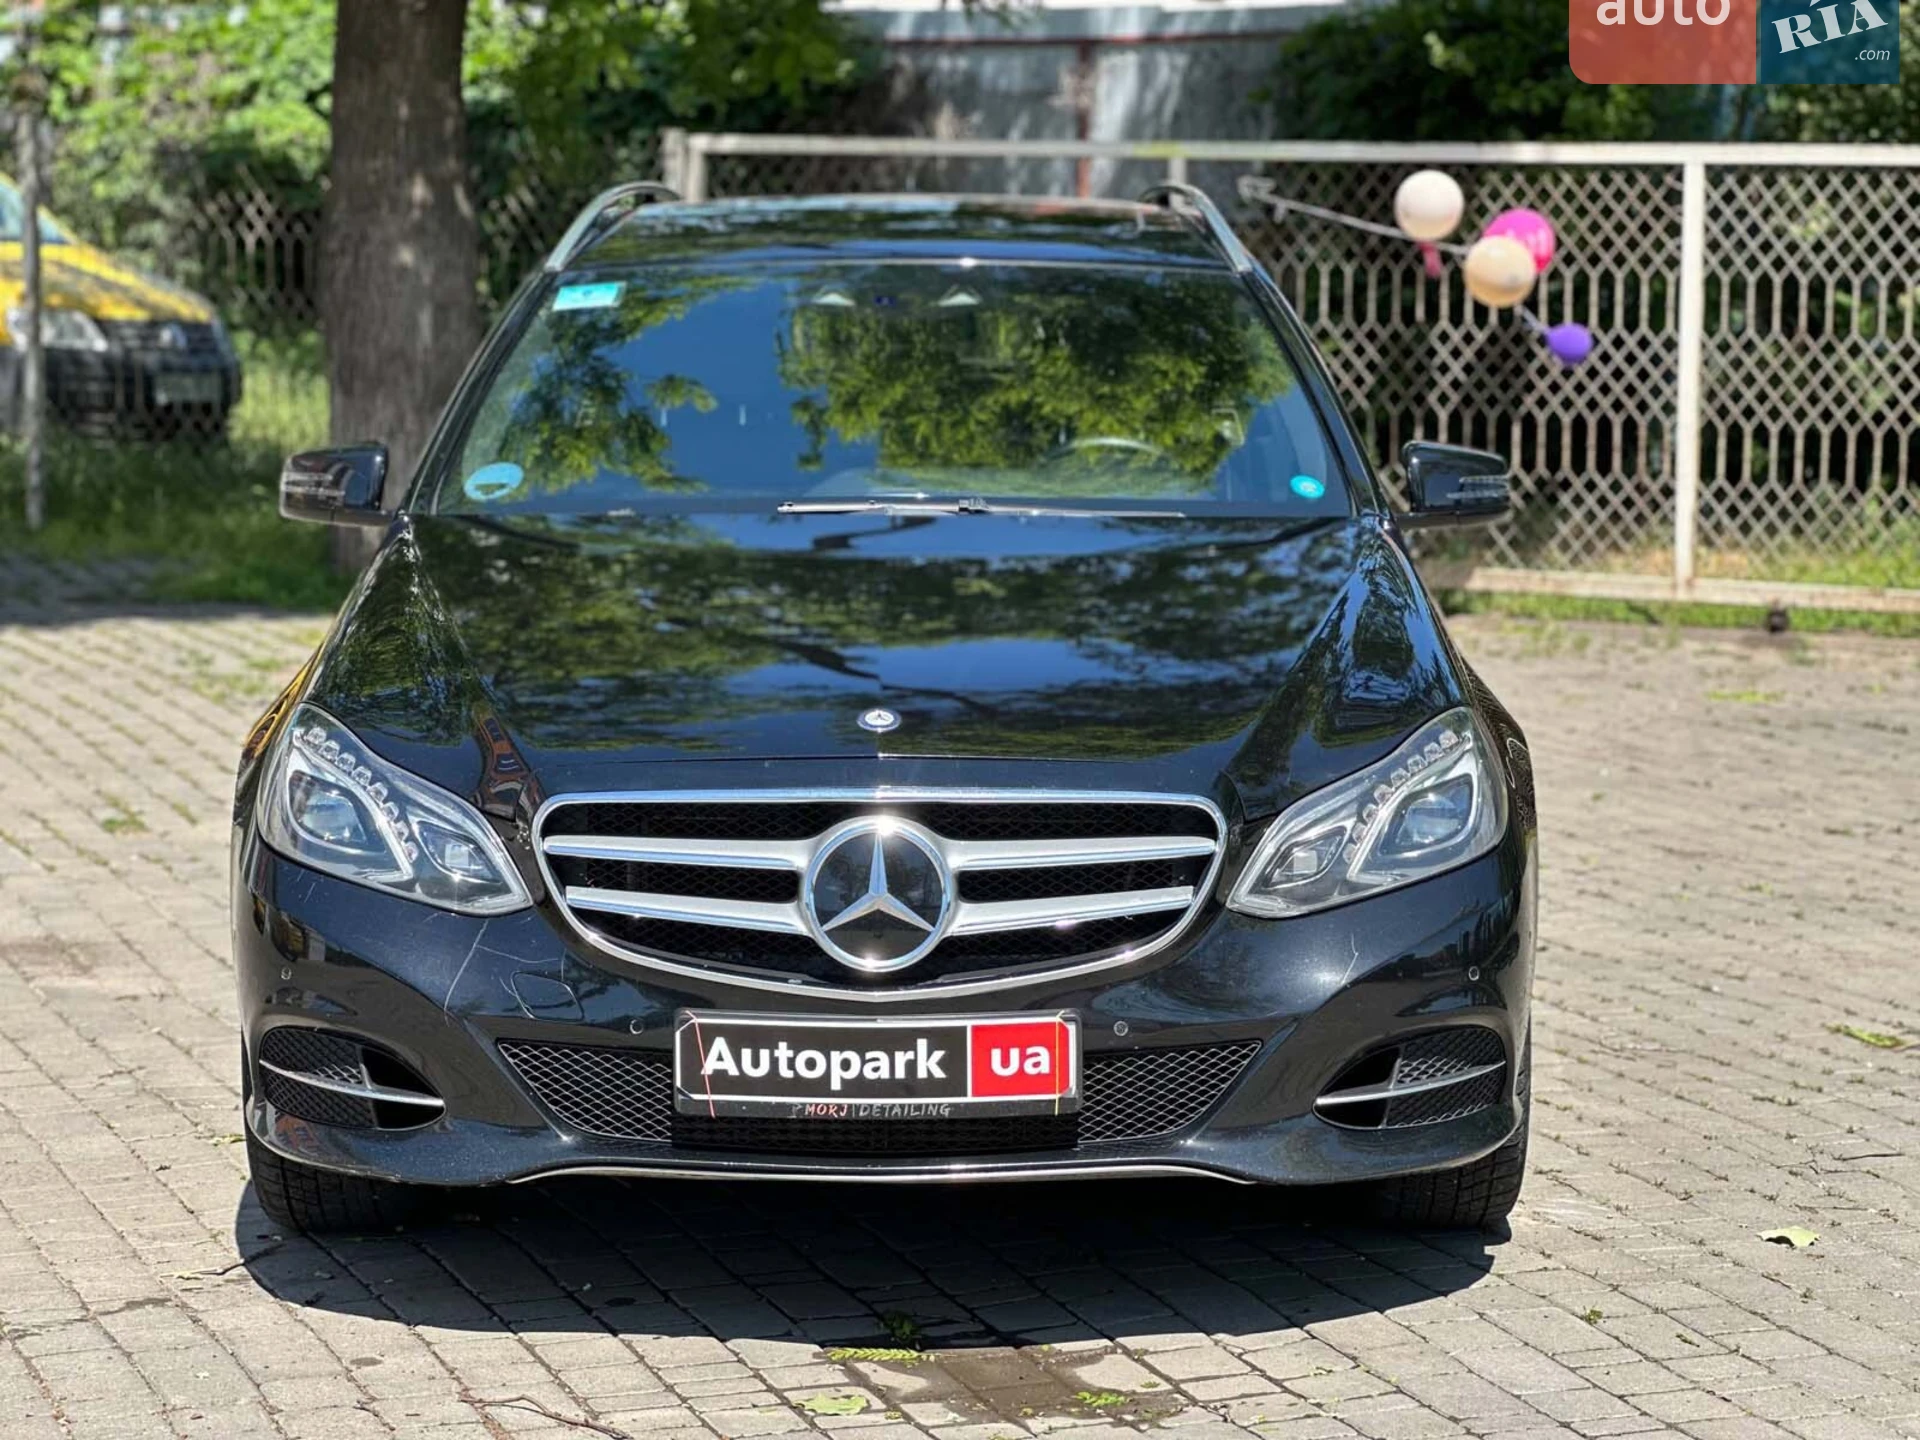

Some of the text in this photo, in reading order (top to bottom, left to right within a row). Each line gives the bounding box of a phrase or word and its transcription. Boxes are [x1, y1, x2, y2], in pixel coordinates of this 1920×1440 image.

[701, 1036, 1052, 1091] Autopark ua
[858, 1103, 952, 1118] DETAILING
